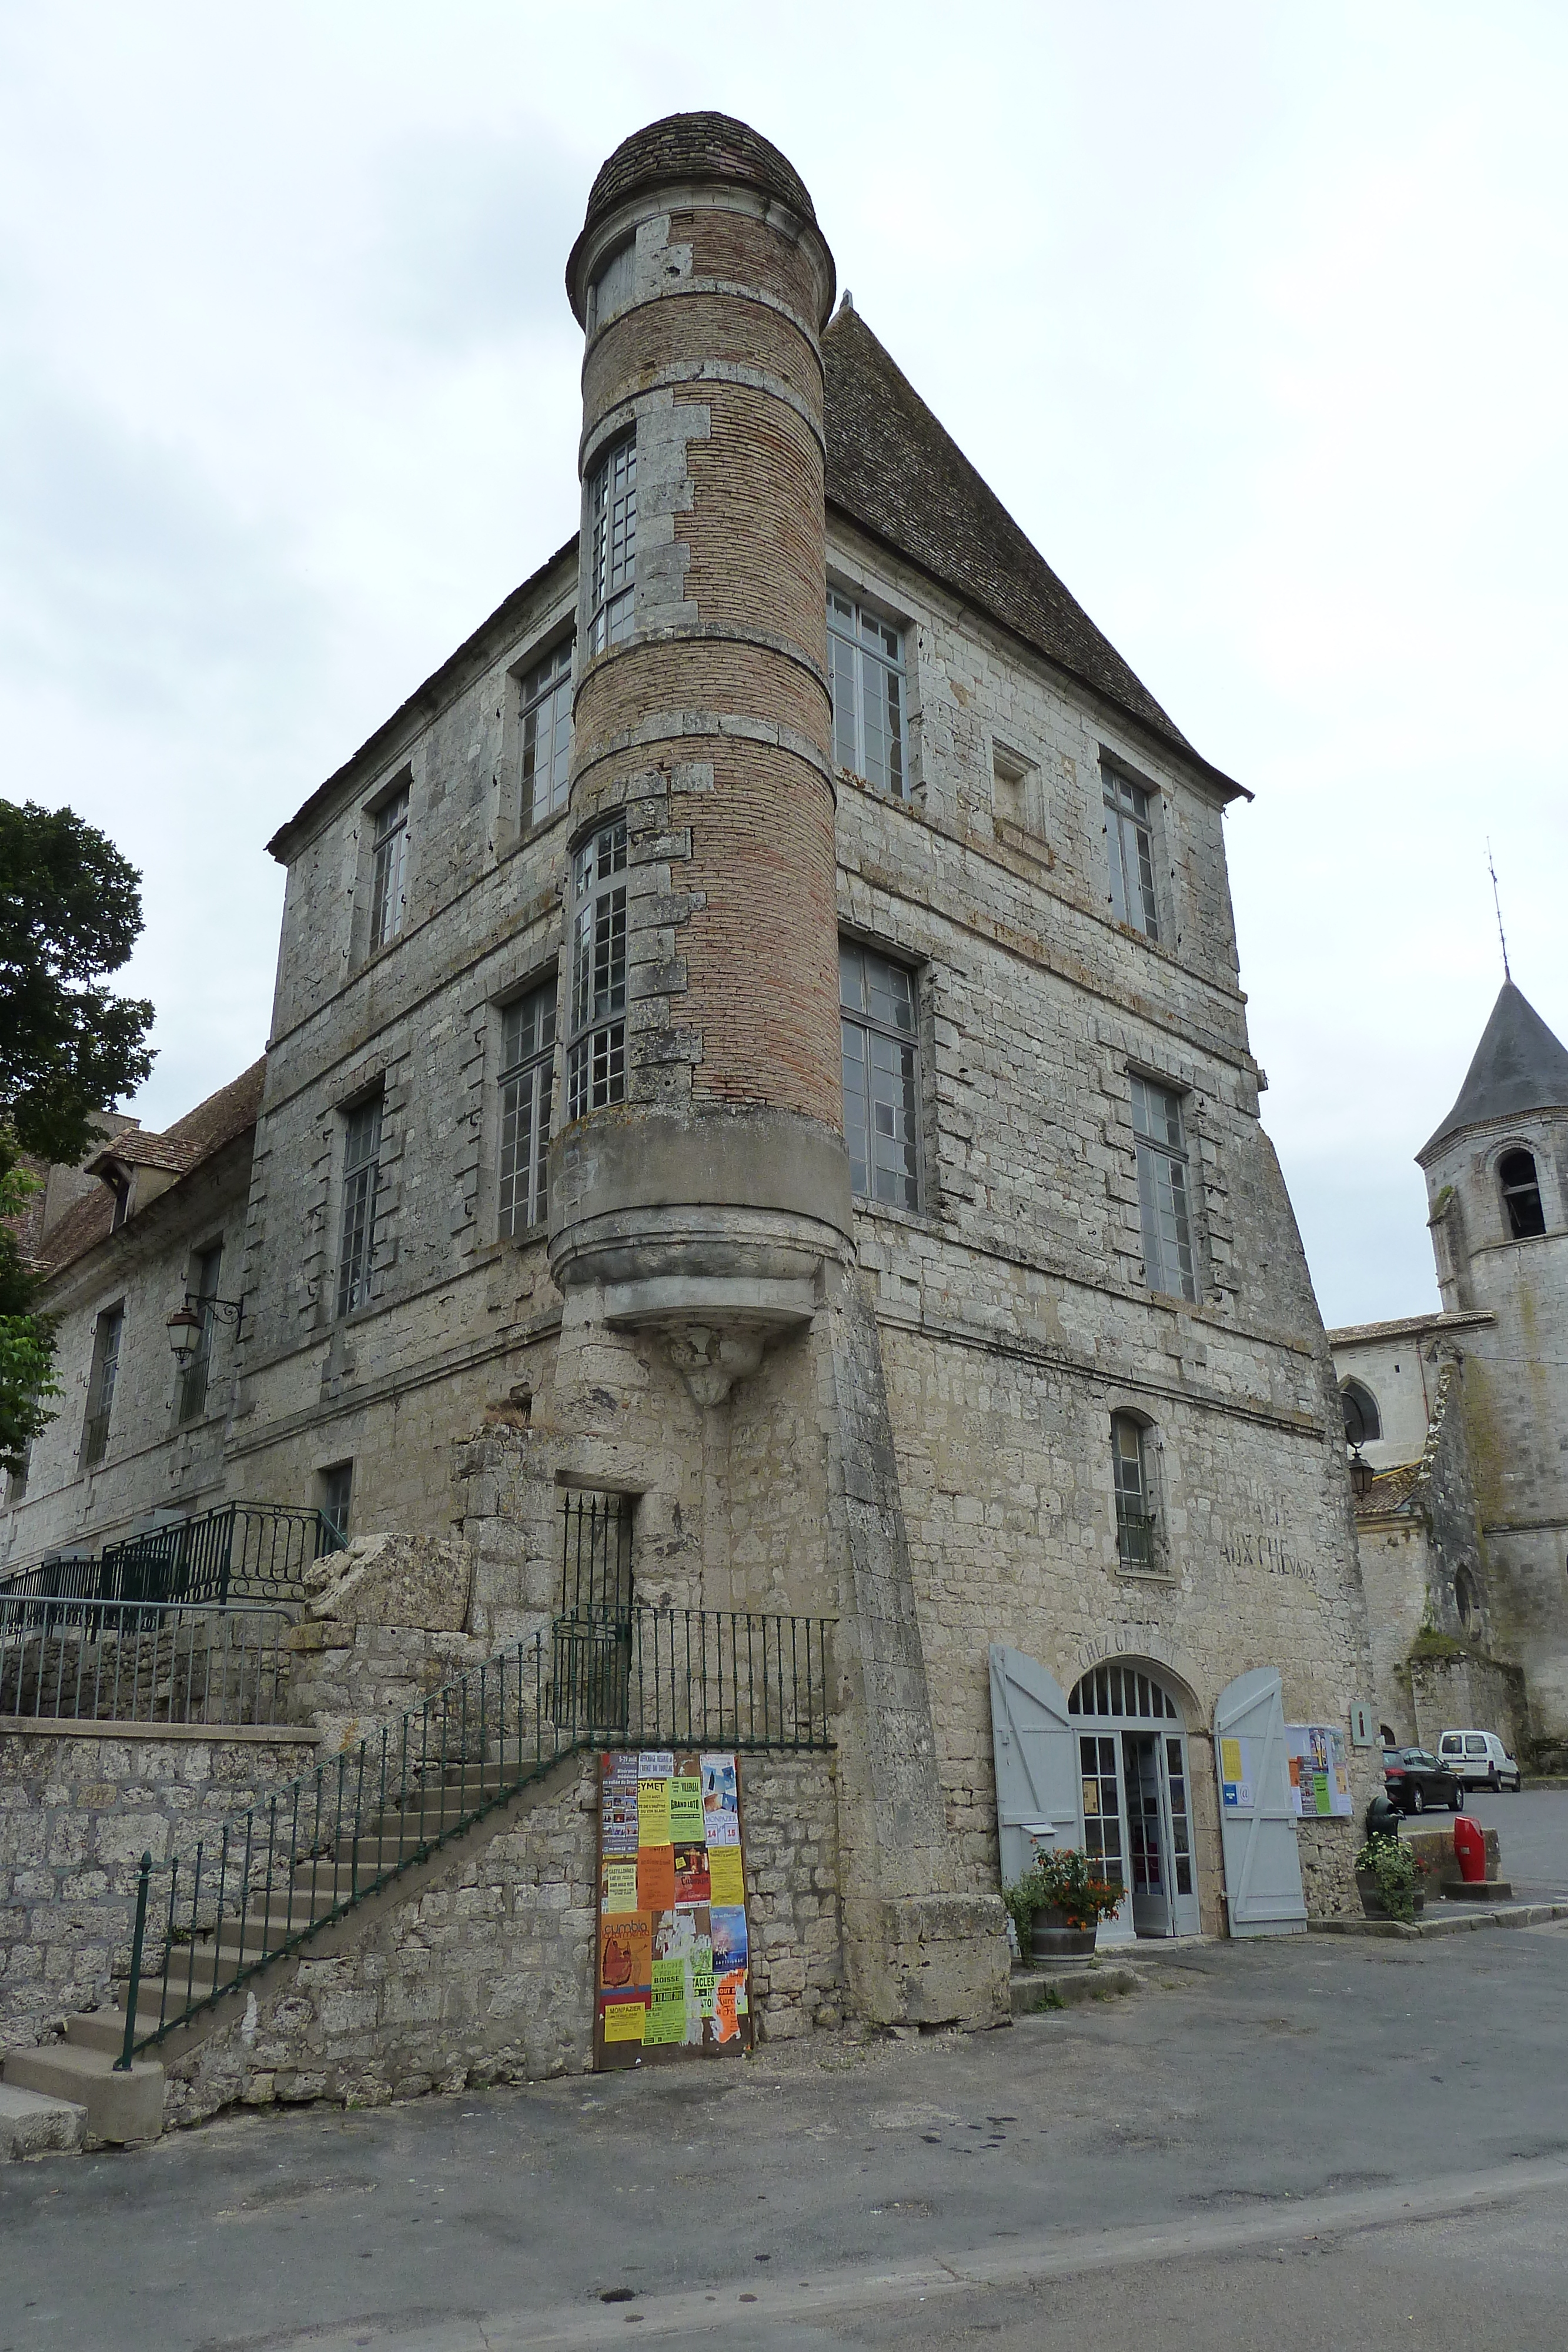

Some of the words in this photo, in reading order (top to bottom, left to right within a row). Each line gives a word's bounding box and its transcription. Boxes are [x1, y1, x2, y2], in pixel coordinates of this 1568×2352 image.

[671, 1799, 687, 1810] GRAND
[688, 1799, 699, 1810] LOTO
[708, 1829, 716, 1838] 14
